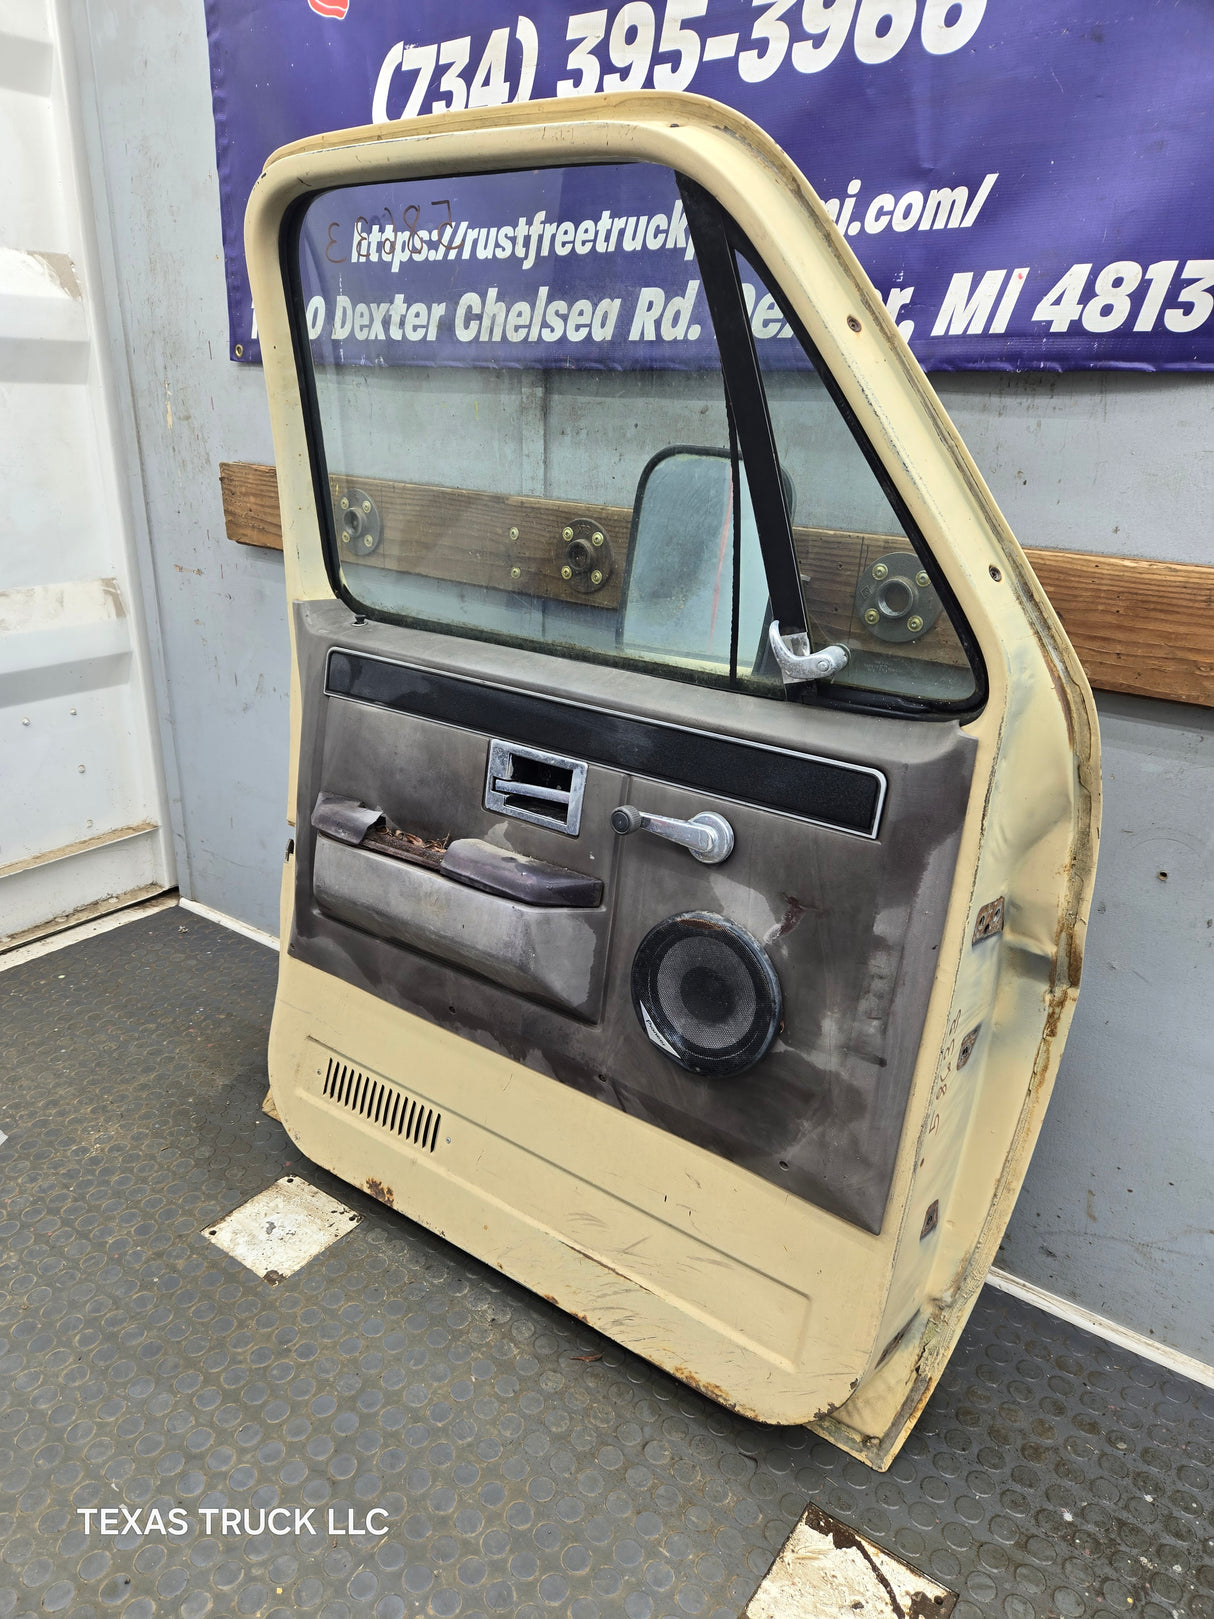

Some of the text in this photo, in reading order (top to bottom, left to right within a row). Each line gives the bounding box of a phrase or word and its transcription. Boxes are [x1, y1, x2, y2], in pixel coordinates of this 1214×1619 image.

[371, 15, 539, 125] (734)
[331, 293, 446, 341] Dexter
[454, 286, 622, 342] Chelsea
[628, 279, 702, 341] Rd.
[930, 267, 1030, 337] MI
